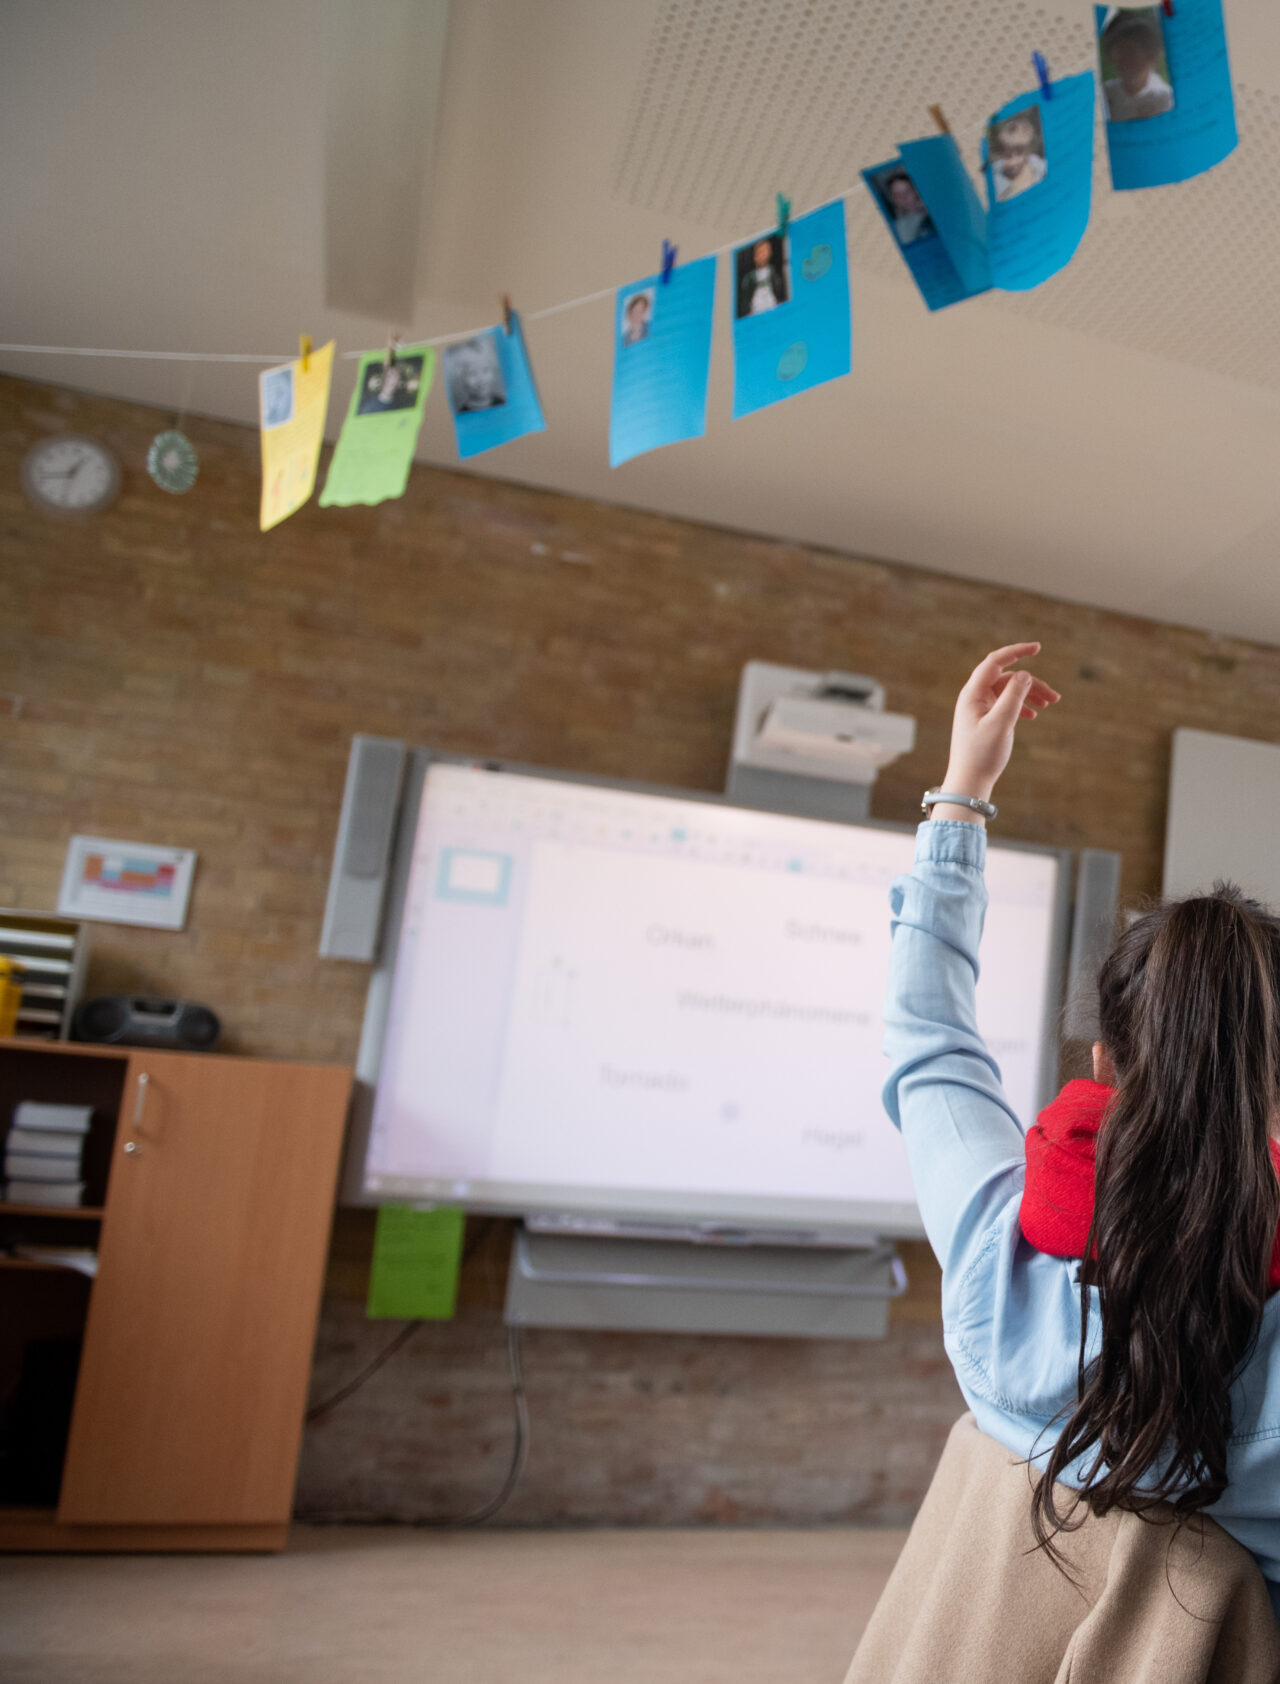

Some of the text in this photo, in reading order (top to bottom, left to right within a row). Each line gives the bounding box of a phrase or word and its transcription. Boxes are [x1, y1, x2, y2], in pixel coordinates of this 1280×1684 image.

[645, 924, 715, 950] Orkan
[785, 919, 863, 946] Schnee
[677, 990, 871, 1027] Wetterphänomene
[600, 1064, 688, 1091] Tornado
[802, 1128, 865, 1151] Hagel
